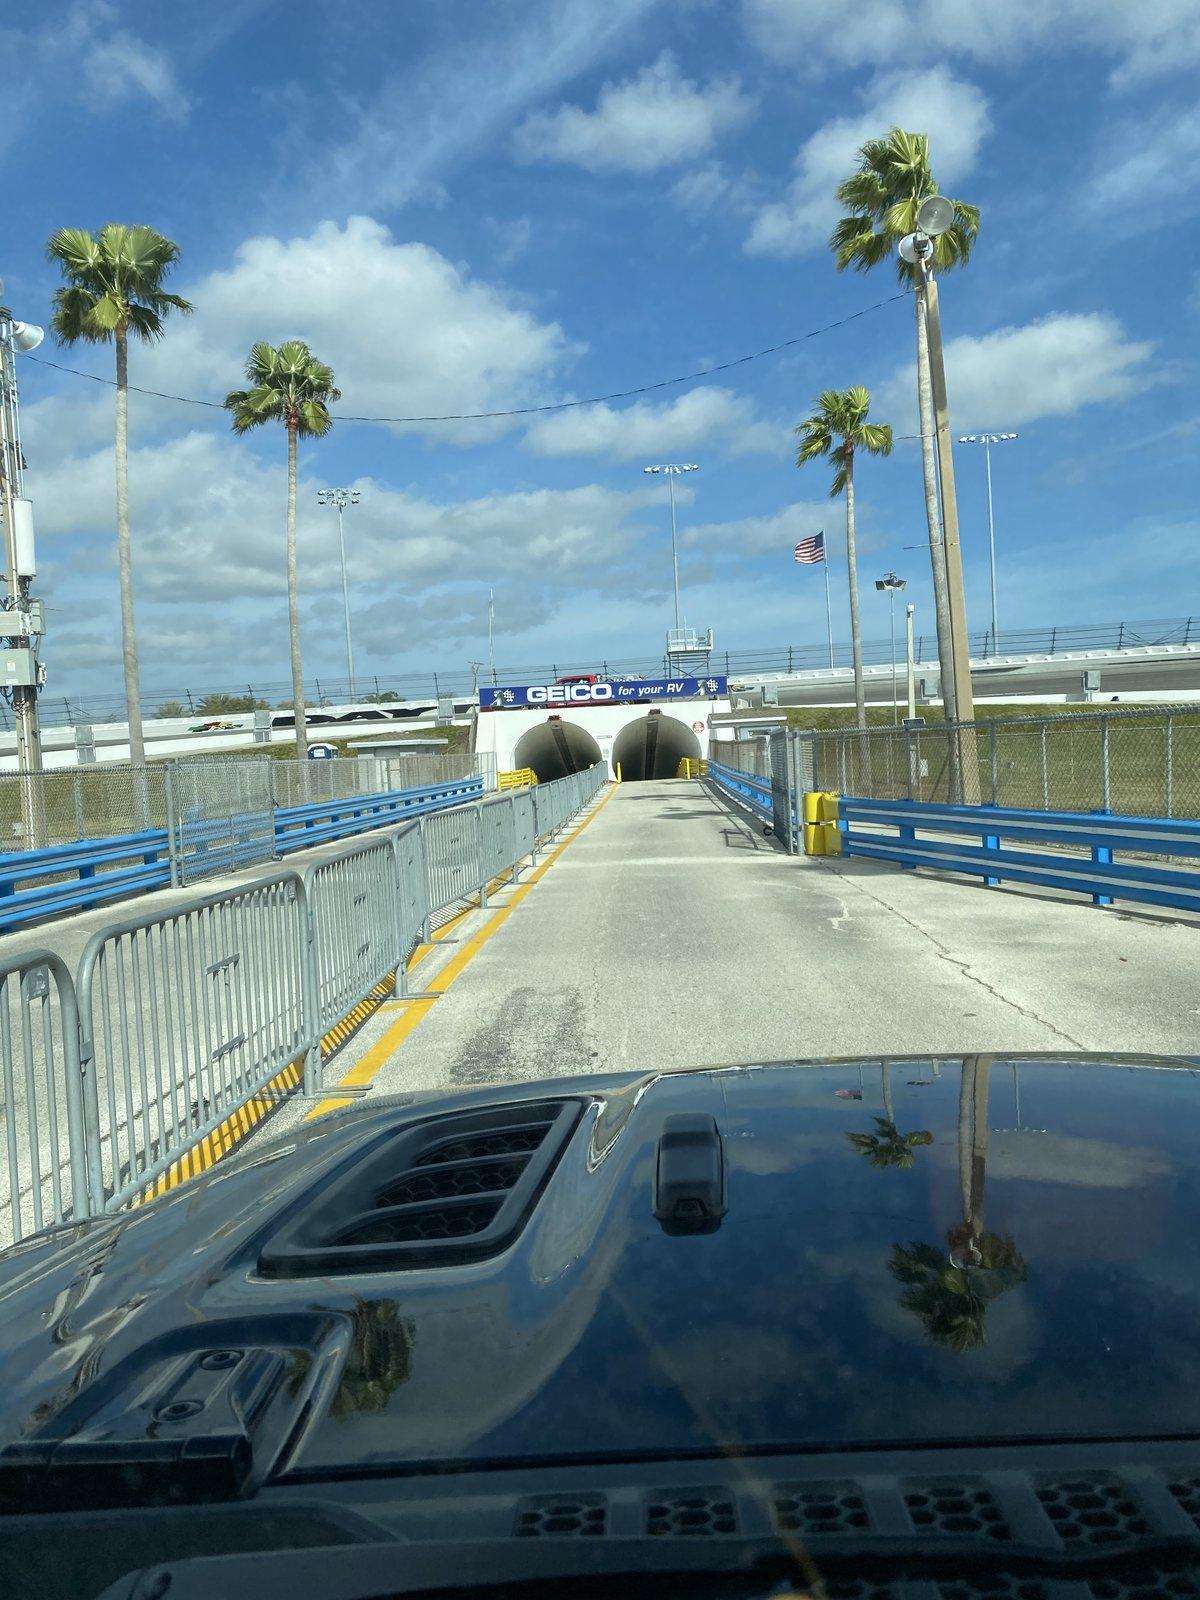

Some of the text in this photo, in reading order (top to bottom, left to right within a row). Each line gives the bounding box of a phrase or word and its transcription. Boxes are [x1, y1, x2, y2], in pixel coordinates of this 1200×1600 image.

[527, 683, 685, 703] GEICO for your RV
